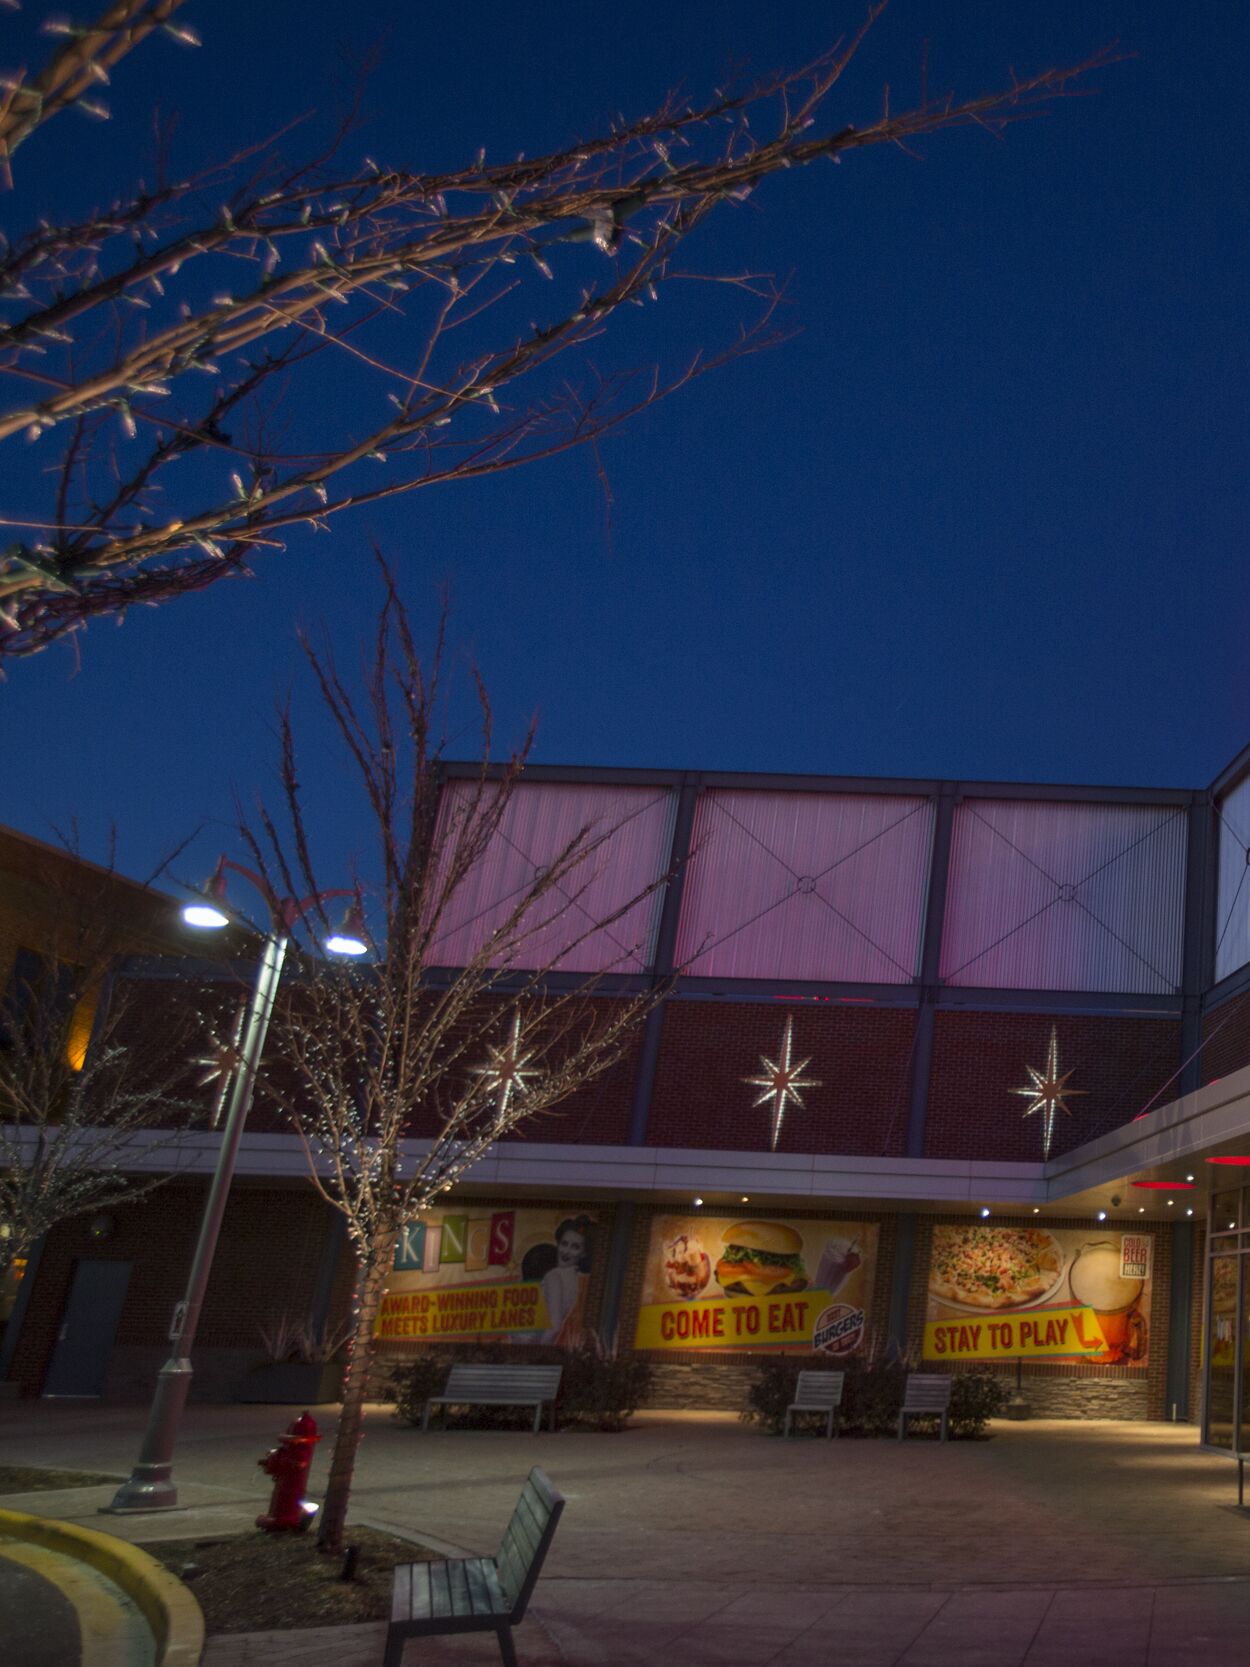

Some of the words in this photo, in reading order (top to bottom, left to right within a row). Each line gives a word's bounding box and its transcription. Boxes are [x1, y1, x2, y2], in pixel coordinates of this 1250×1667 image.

[399, 1218, 511, 1265] KINGS
[1123, 1248, 1147, 1264] BEER
[381, 1289, 498, 1315] AWARD-WINNING
[503, 1287, 539, 1306] FOOD
[381, 1315, 429, 1335] MEETS
[432, 1310, 487, 1332] LUXURY
[491, 1308, 536, 1327] LANES
[660, 1307, 725, 1341] COME
[732, 1304, 761, 1336] TO
[768, 1301, 809, 1333] EAT
[814, 1310, 864, 1347] BURGERS
[934, 1323, 983, 1354] STAY
[987, 1322, 1014, 1350] TO
[1020, 1318, 1069, 1348] PLAY
